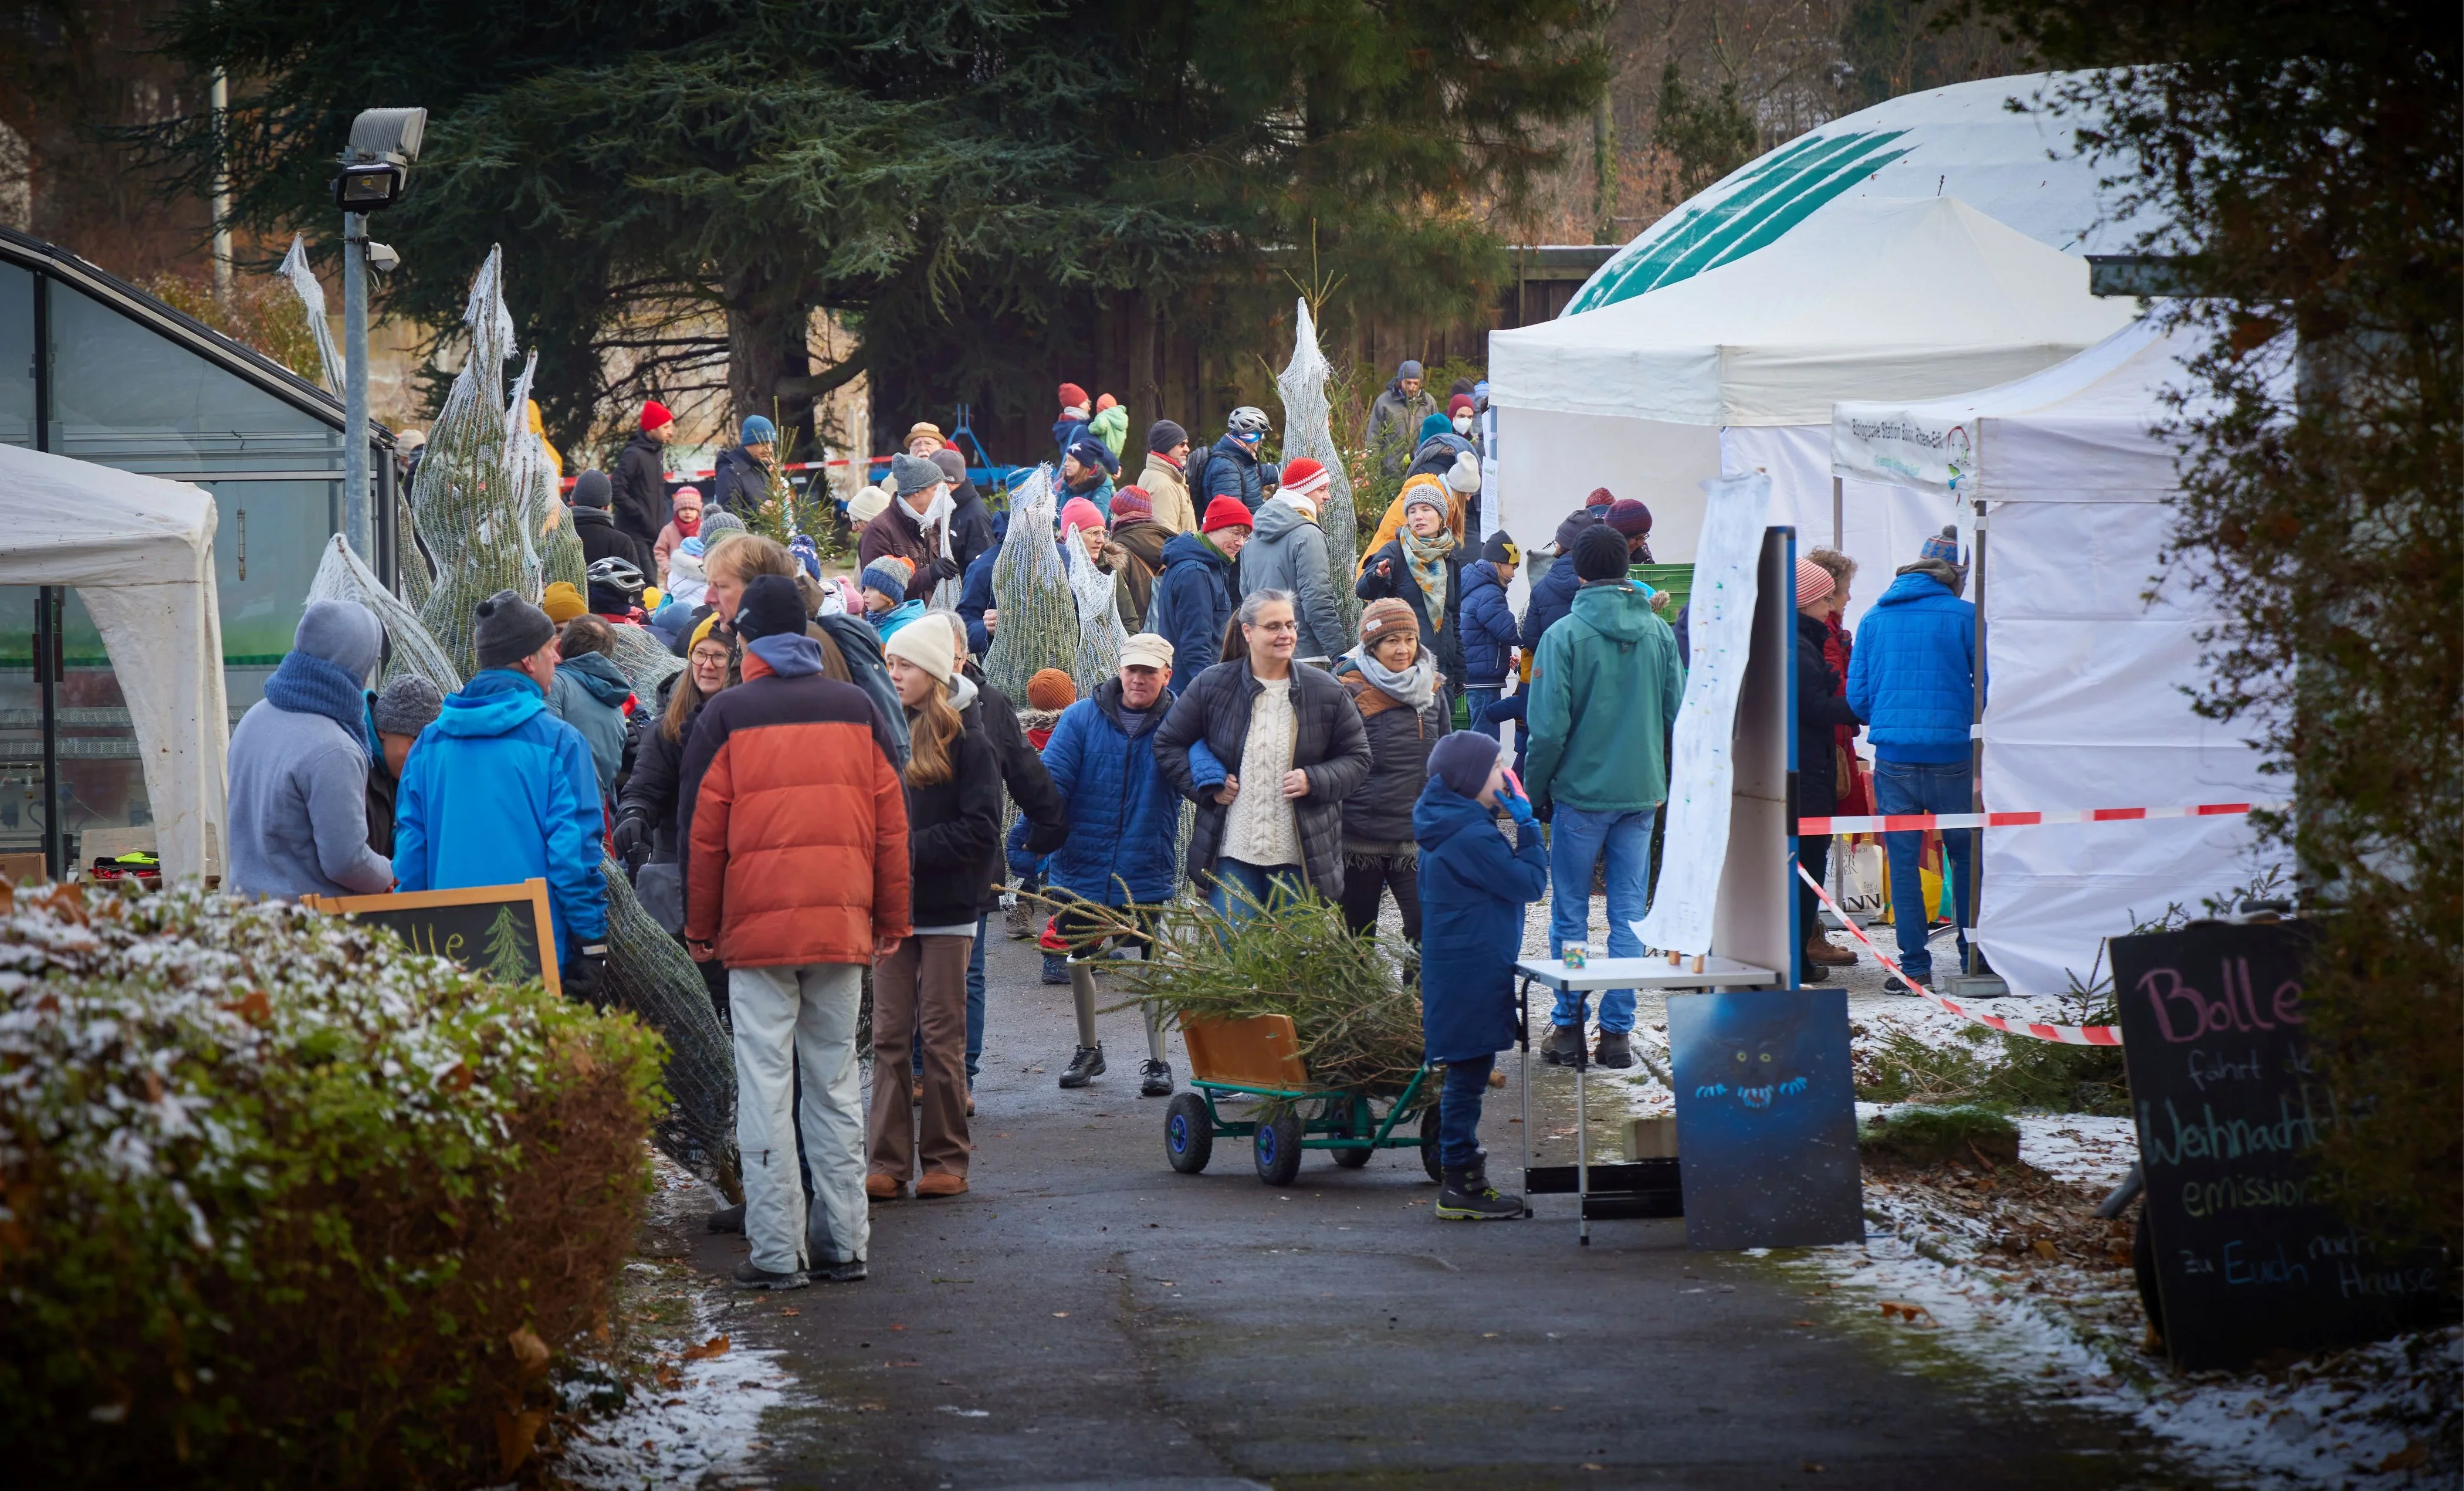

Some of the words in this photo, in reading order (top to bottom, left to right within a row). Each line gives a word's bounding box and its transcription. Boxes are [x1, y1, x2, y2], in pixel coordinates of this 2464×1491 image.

[2135, 955, 2306, 1042] Bolle
[2223, 1239, 2309, 1285] Euch
[2338, 1260, 2438, 1299] Hause
